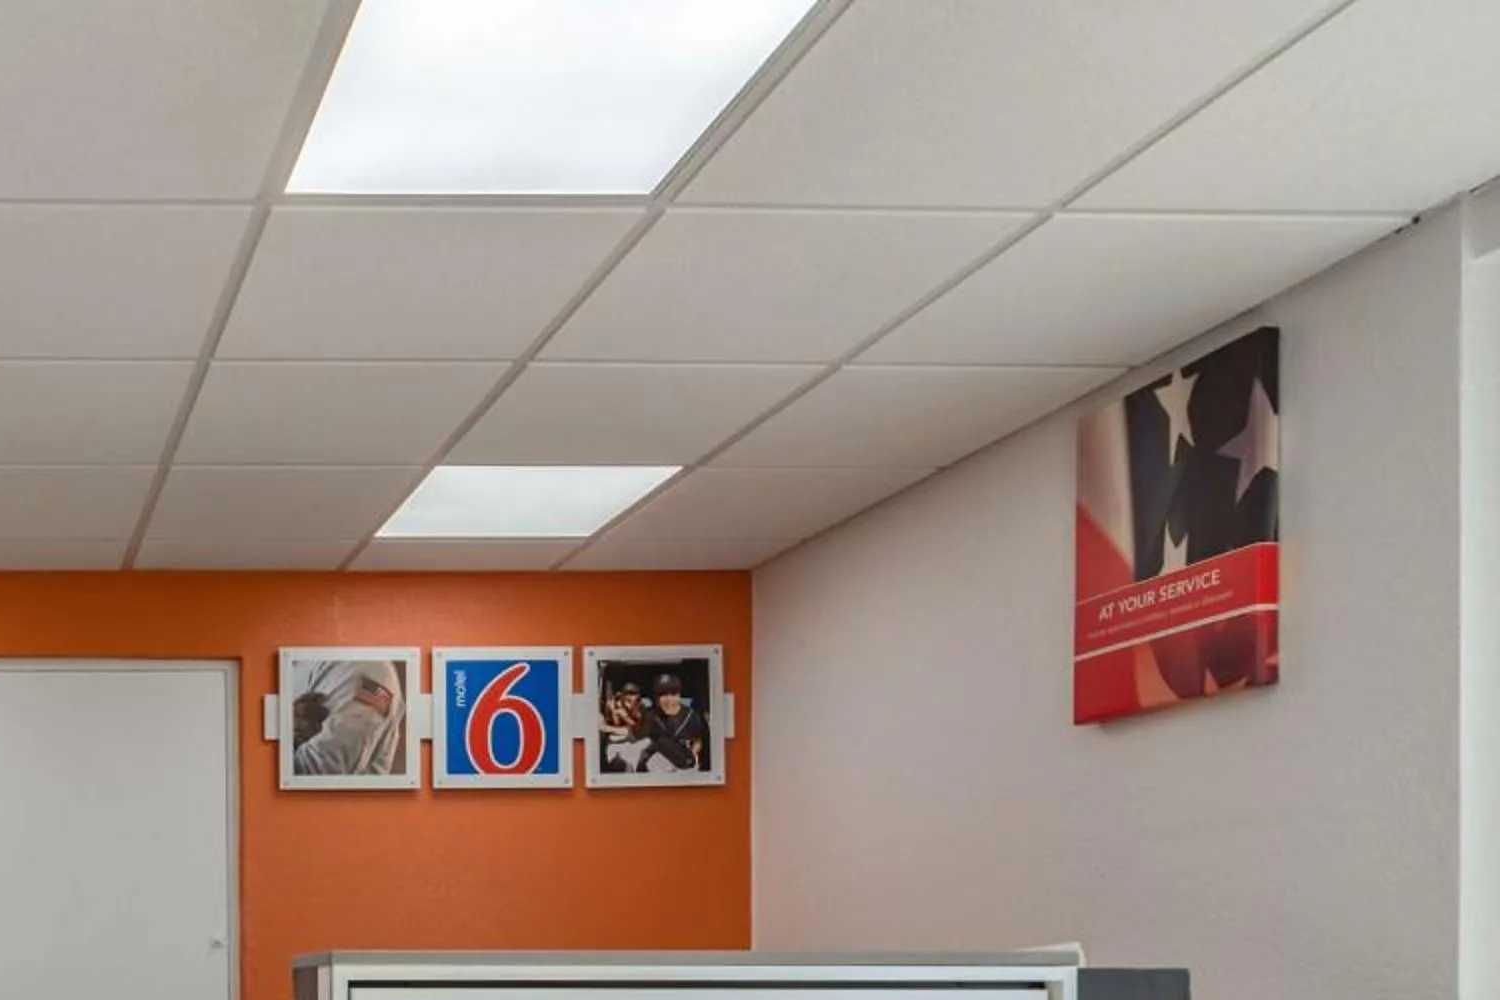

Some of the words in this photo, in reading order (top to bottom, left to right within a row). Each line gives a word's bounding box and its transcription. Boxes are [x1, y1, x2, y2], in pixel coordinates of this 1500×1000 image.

[1097, 601, 1115, 623] AT
[1117, 590, 1156, 615] YOUR
[1158, 568, 1222, 603] SERVICE
[453, 669, 467, 708] motel
[465, 662, 545, 775] 6
